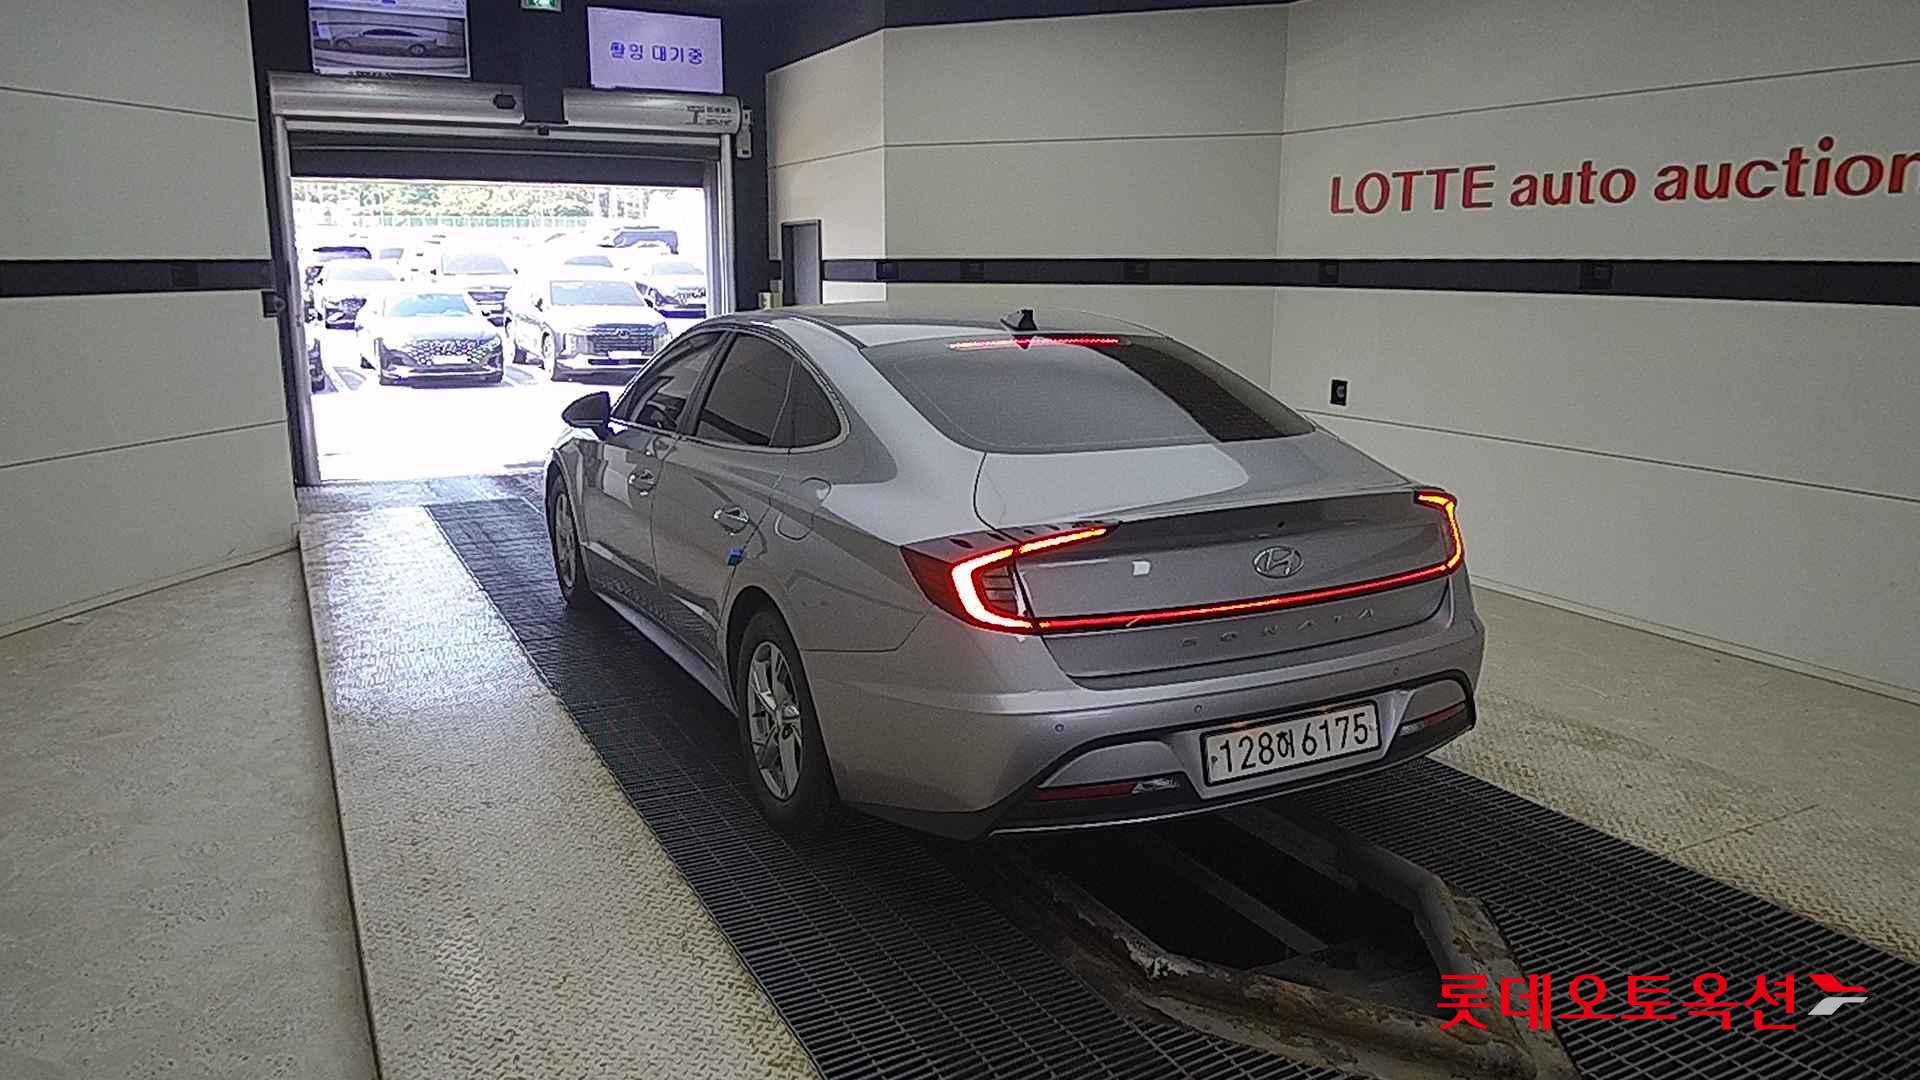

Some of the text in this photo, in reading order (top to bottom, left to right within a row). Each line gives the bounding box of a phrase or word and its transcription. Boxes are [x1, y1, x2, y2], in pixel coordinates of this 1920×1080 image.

[652, 45, 703, 65] 대기중
[1330, 136, 1920, 215] LOTTE auto auction
